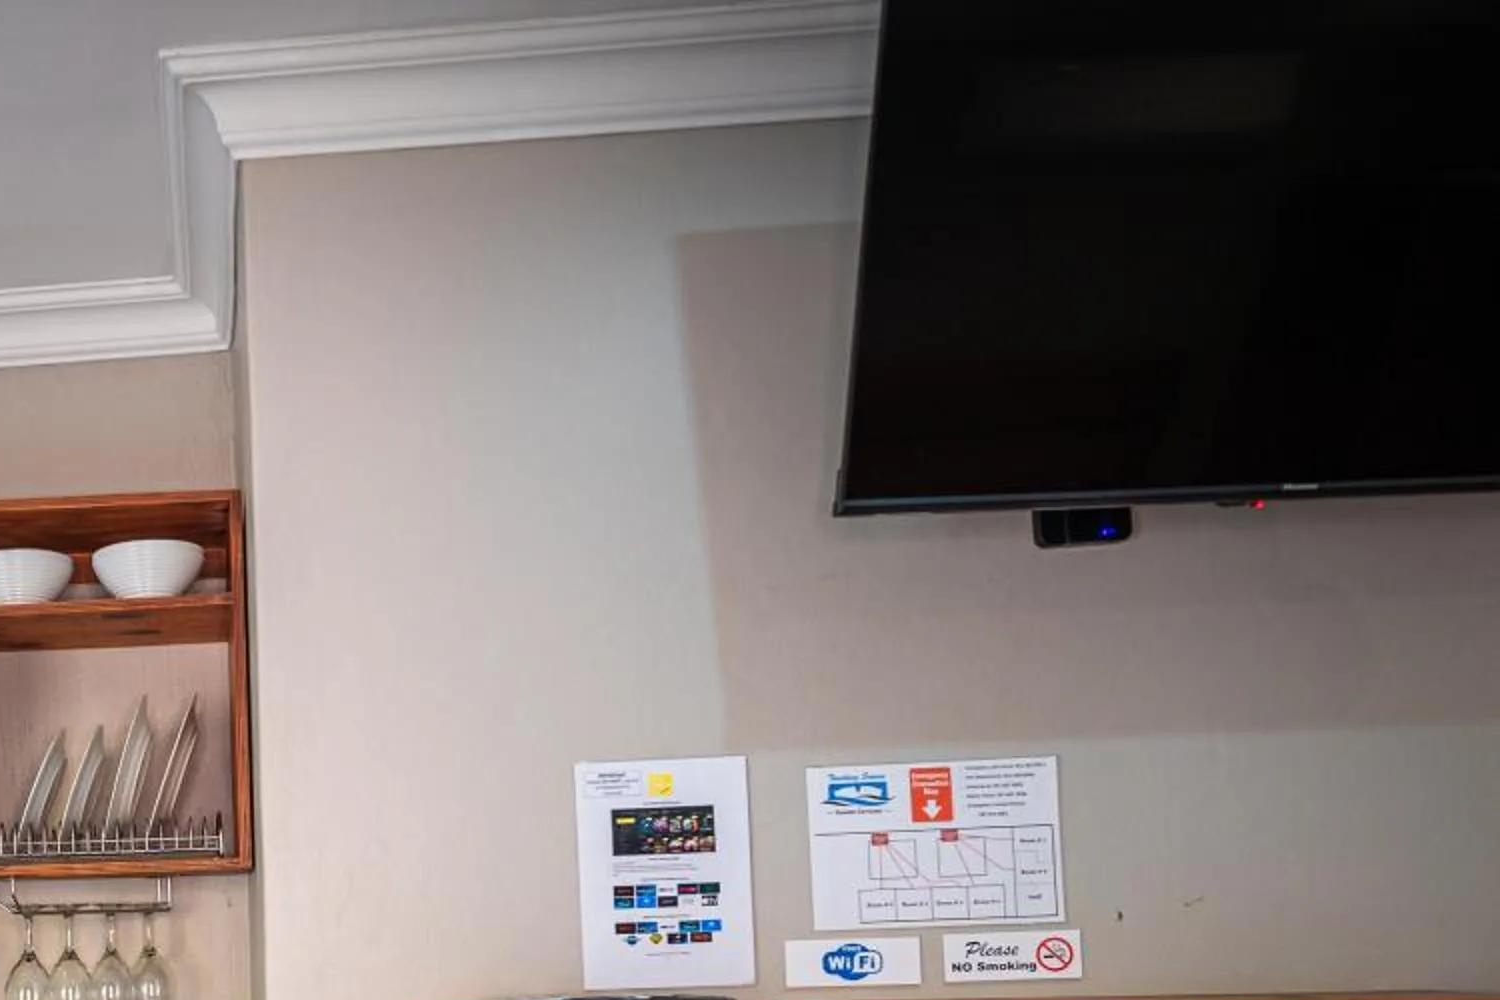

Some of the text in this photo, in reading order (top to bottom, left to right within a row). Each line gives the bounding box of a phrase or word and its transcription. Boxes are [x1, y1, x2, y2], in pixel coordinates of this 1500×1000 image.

[964, 941, 1019, 959] Please
[952, 961, 1037, 973] NO Smoking
